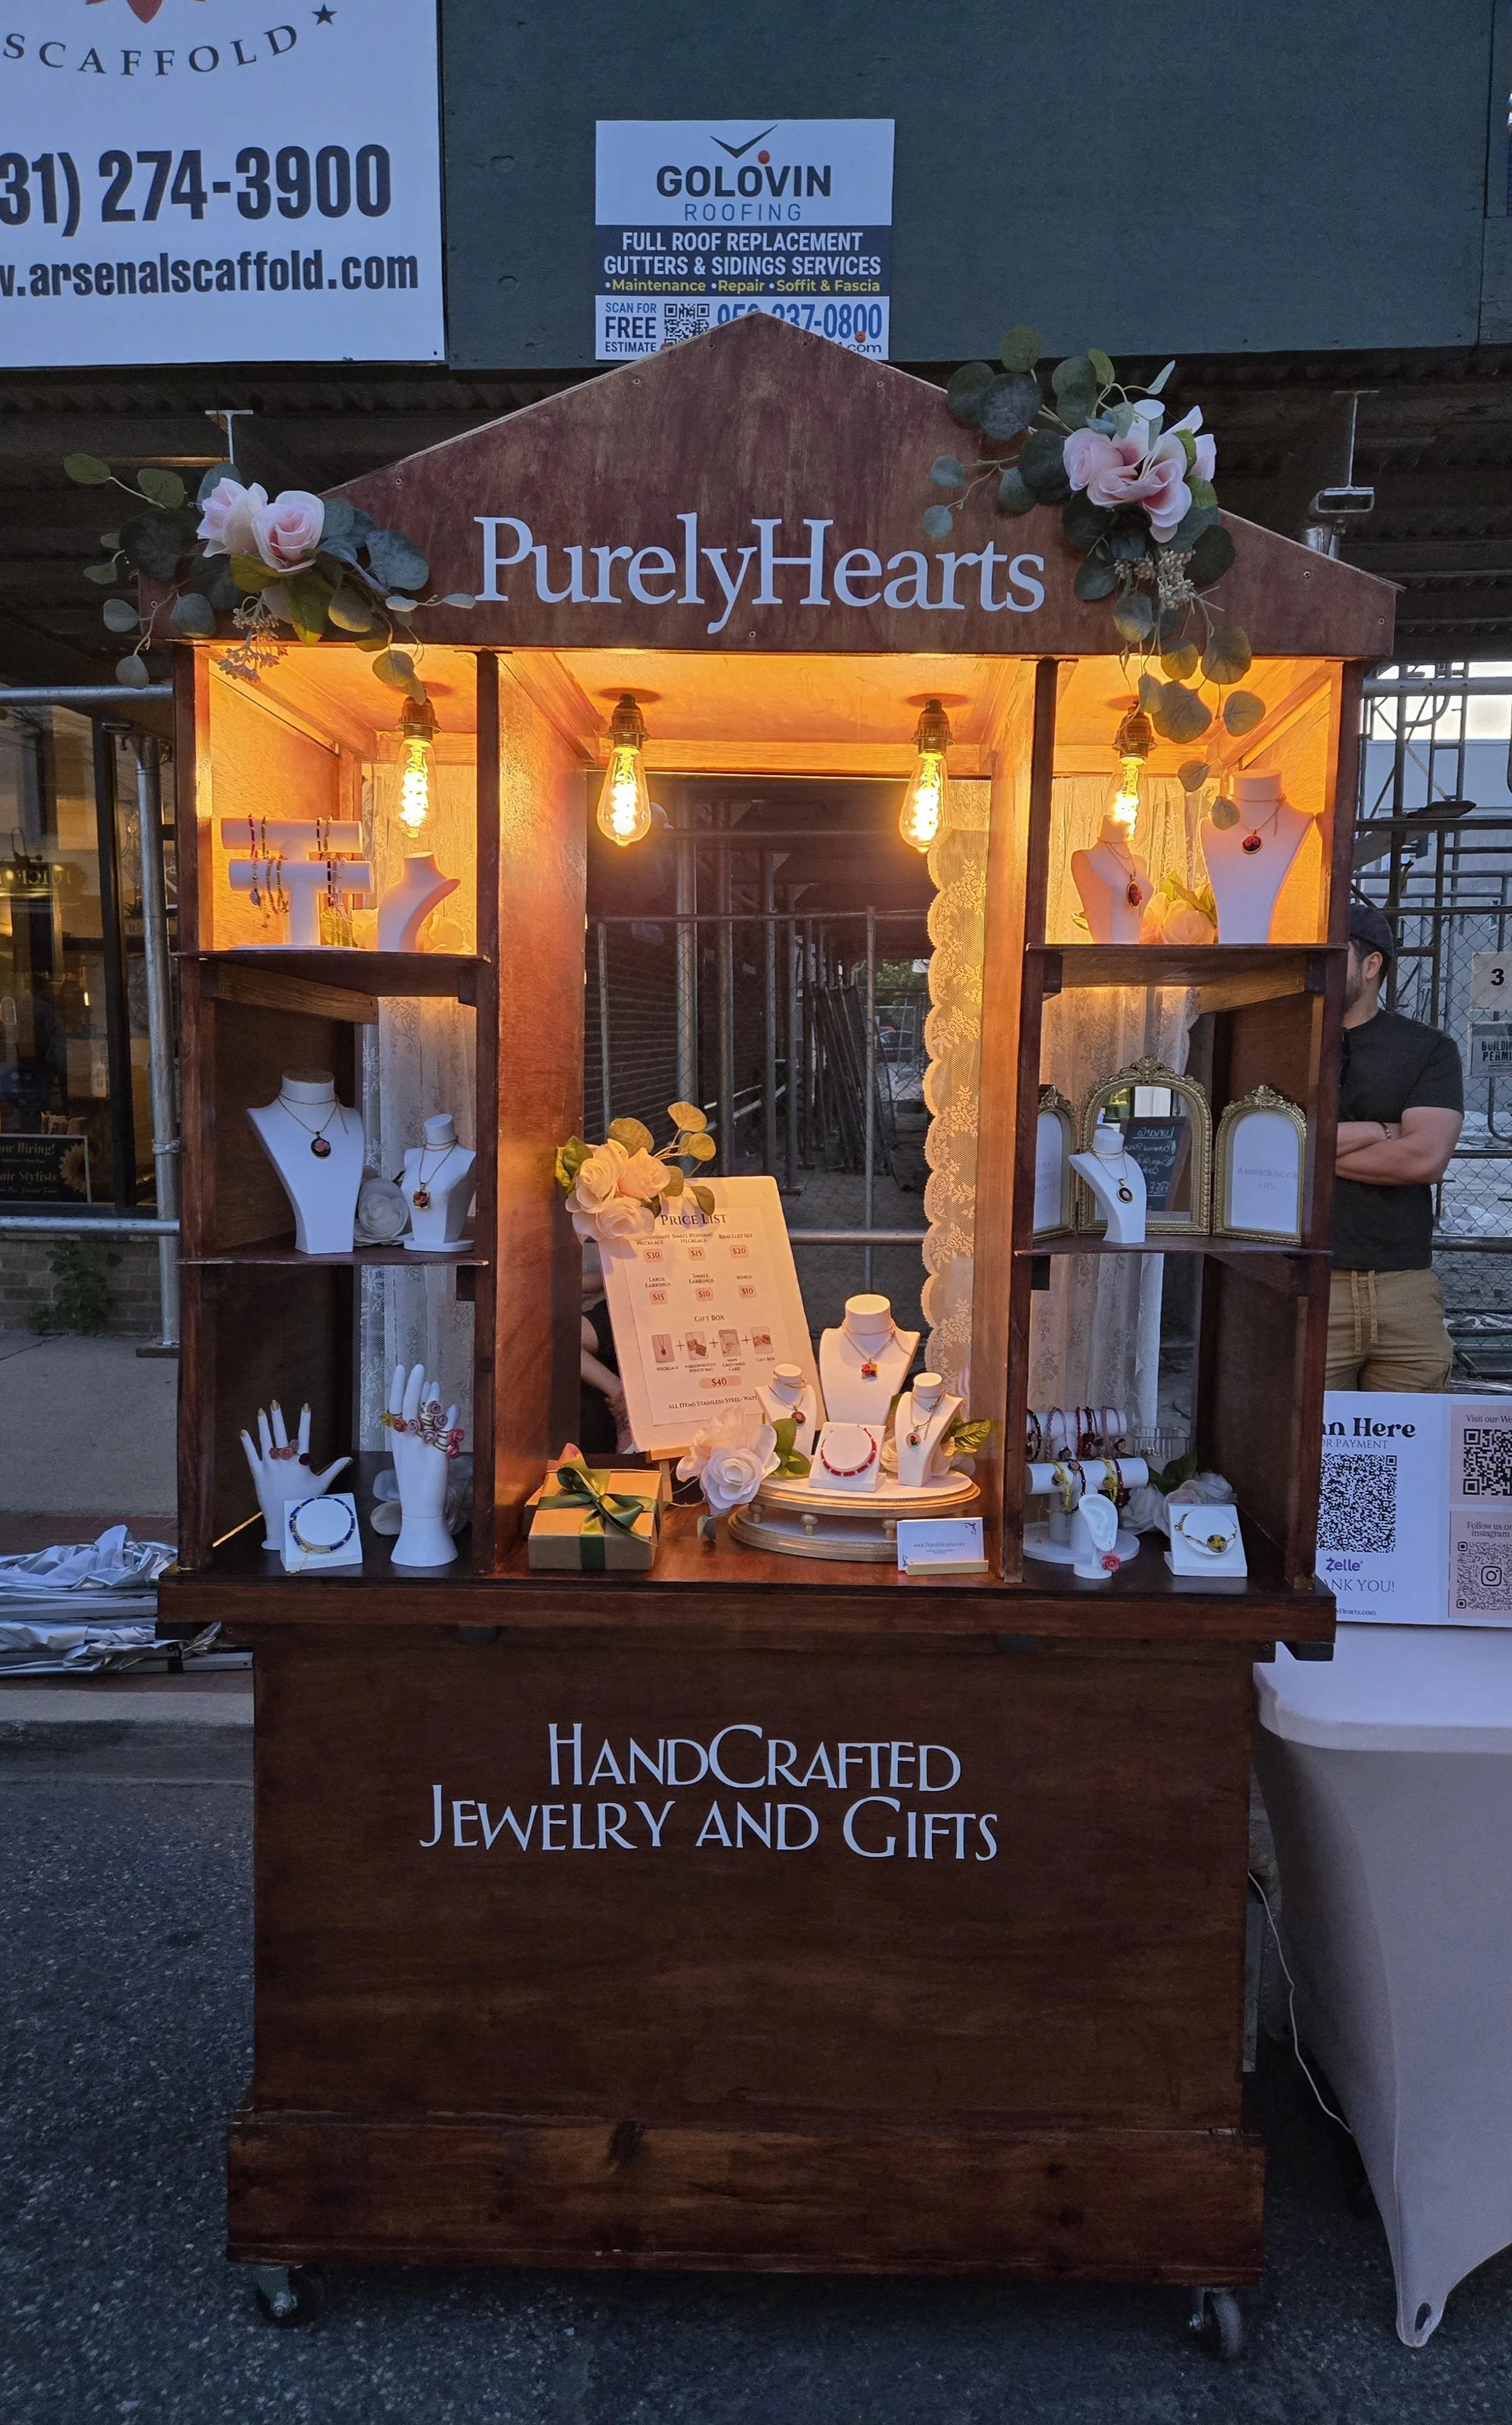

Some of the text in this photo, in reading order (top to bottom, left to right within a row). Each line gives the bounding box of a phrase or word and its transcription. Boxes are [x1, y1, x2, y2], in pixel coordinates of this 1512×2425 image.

[2, 25, 298, 76] SCAFFOLD
[98, 144, 391, 222] 274-3900
[657, 165, 831, 197] GOLOVIN
[684, 204, 801, 221] ROOFING
[623, 232, 863, 251] FULL ROOF REPLACEMENT
[604, 256, 881, 275] GUTTERS & SIDINGS SERVICES
[820, 280, 831, 292] &
[834, 279, 880, 292] Fascia
[605, 303, 657, 313] SCAN FOR
[605, 316, 657, 338] FREE
[605, 341, 657, 353] ESTIMATE
[473, 512, 1046, 634] PurelyHearts
[1491, 968, 1504, 986] 3
[660, 1213, 727, 1225] PRICE LIST
[646, 1251, 660, 1260] $30
[711, 1377, 728, 1386] $40
[1465, 1414, 1483, 1422] Visit
[1353, 1417, 1416, 1437] Here
[1336, 1439, 1388, 1449] PAYMENT
[1467, 1521, 1492, 1530] Follow
[1471, 1529, 1510, 1539] instagram
[1357, 1579, 1394, 1593] YOU!
